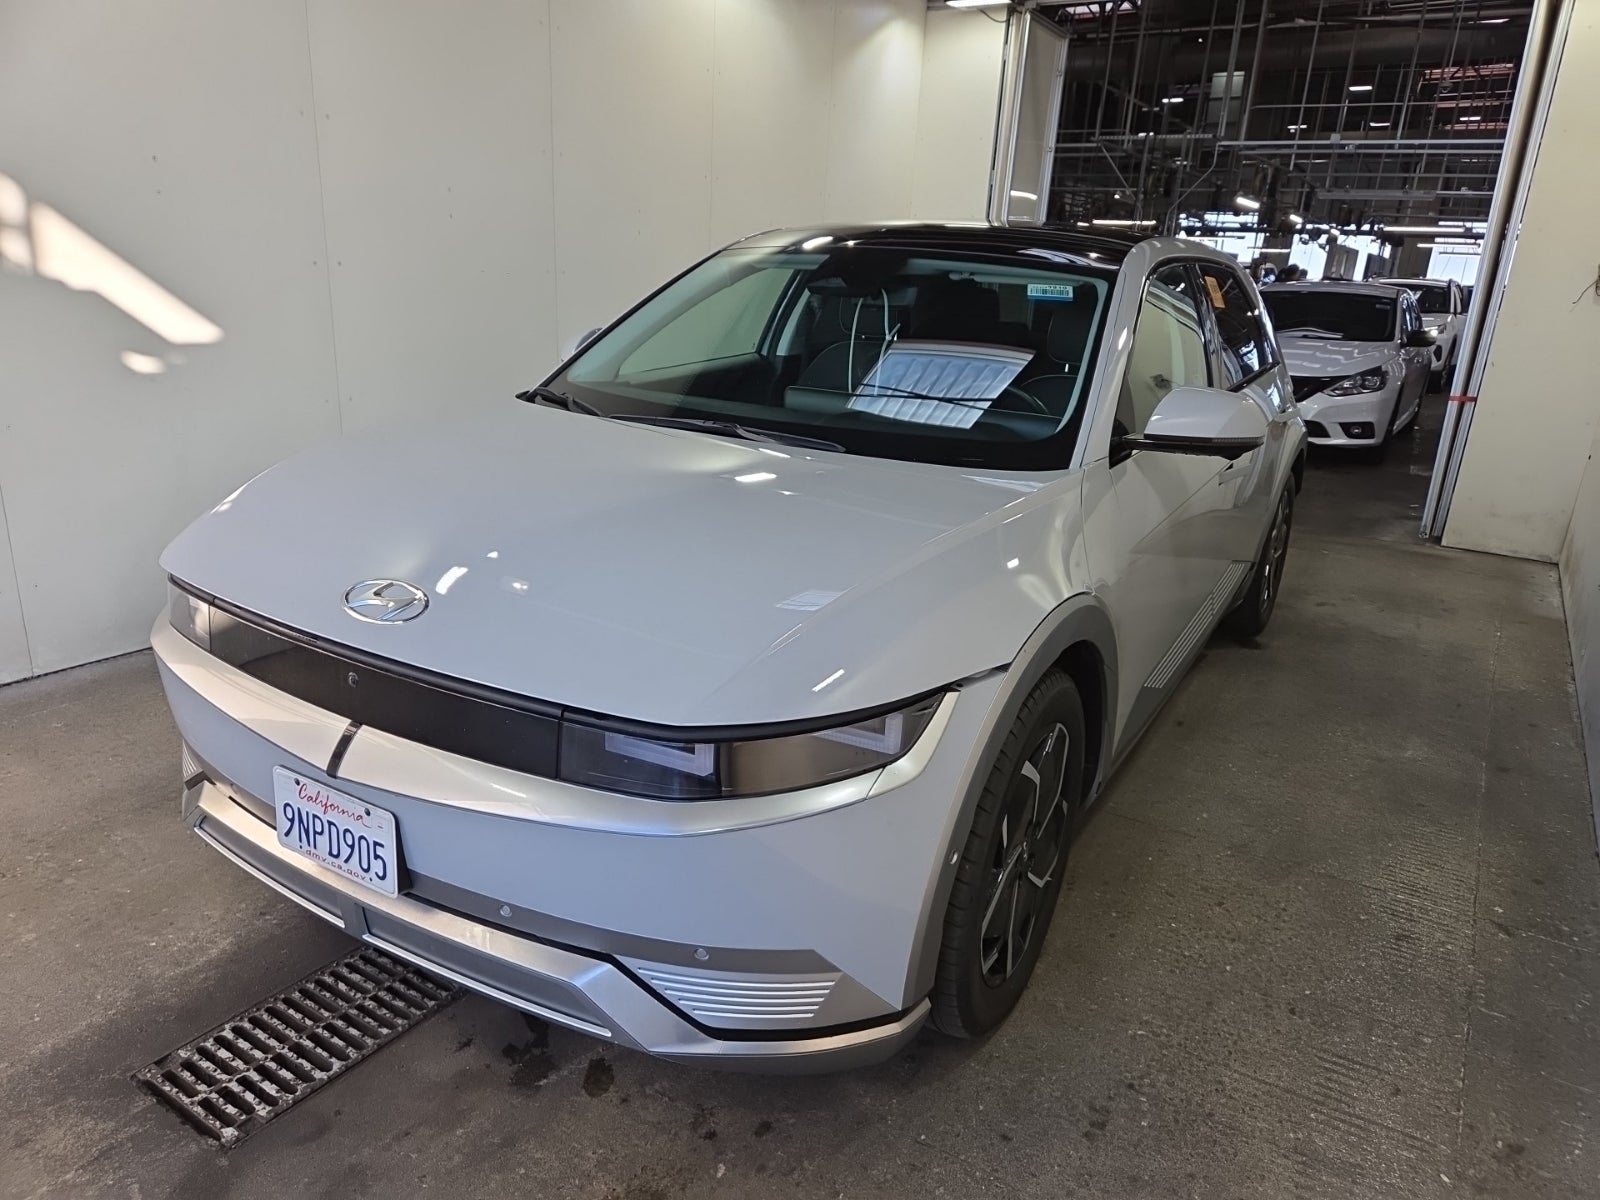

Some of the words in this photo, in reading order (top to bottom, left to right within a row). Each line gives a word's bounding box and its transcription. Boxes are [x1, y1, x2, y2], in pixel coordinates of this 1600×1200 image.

[298, 783, 371, 829] California
[283, 802, 387, 881] 9NPD905
[305, 849, 366, 880] dmv.ca.gov
